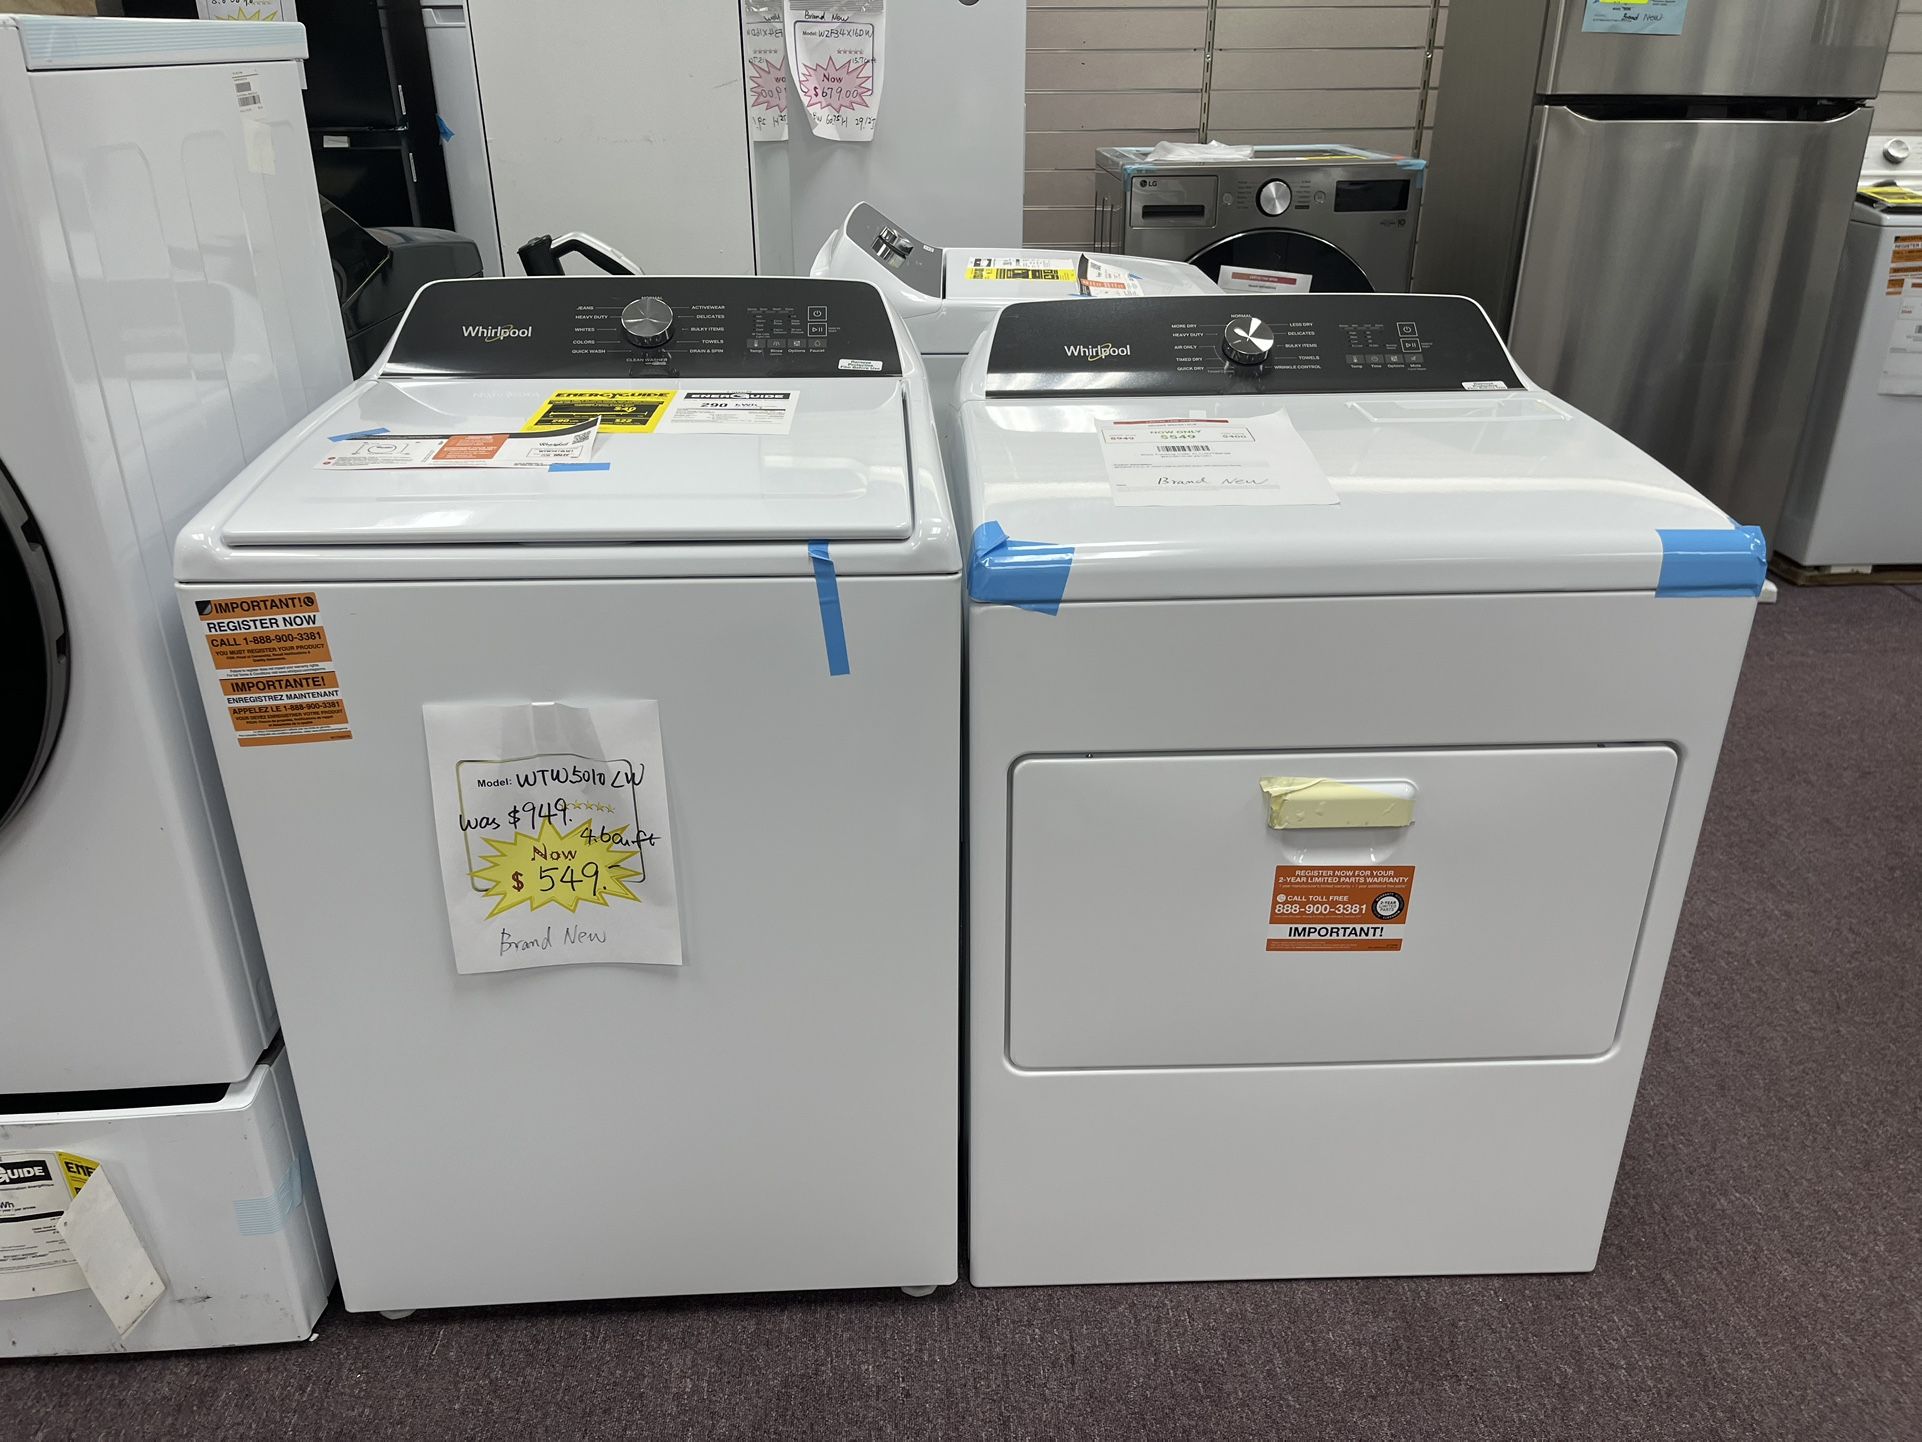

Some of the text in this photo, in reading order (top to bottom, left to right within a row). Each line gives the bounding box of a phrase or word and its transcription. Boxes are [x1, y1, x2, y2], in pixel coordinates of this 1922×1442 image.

[822, 73, 843, 83] Now
[462, 326, 532, 340] Whirlpool
[1064, 345, 1130, 359] Whirlpool
[214, 597, 302, 614] IMPORTANT!
[207, 614, 317, 633] REGISTER NOW
[211, 632, 321, 648] CALL 1-888-900-3381
[231, 676, 326, 692] IMPORTANTE!
[227, 690, 340, 704] ENREGISTREZ MAINTENANT
[232, 705, 269, 715] APPELEZ
[284, 701, 340, 711] 1-888-900-3381
[477, 779, 512, 788] Model:
[531, 843, 577, 861] Now
[1275, 904, 1367, 914] 888-900-3381
[1288, 927, 1384, 937] IMPORTANT!
[500, 925, 607, 956] Brand New
